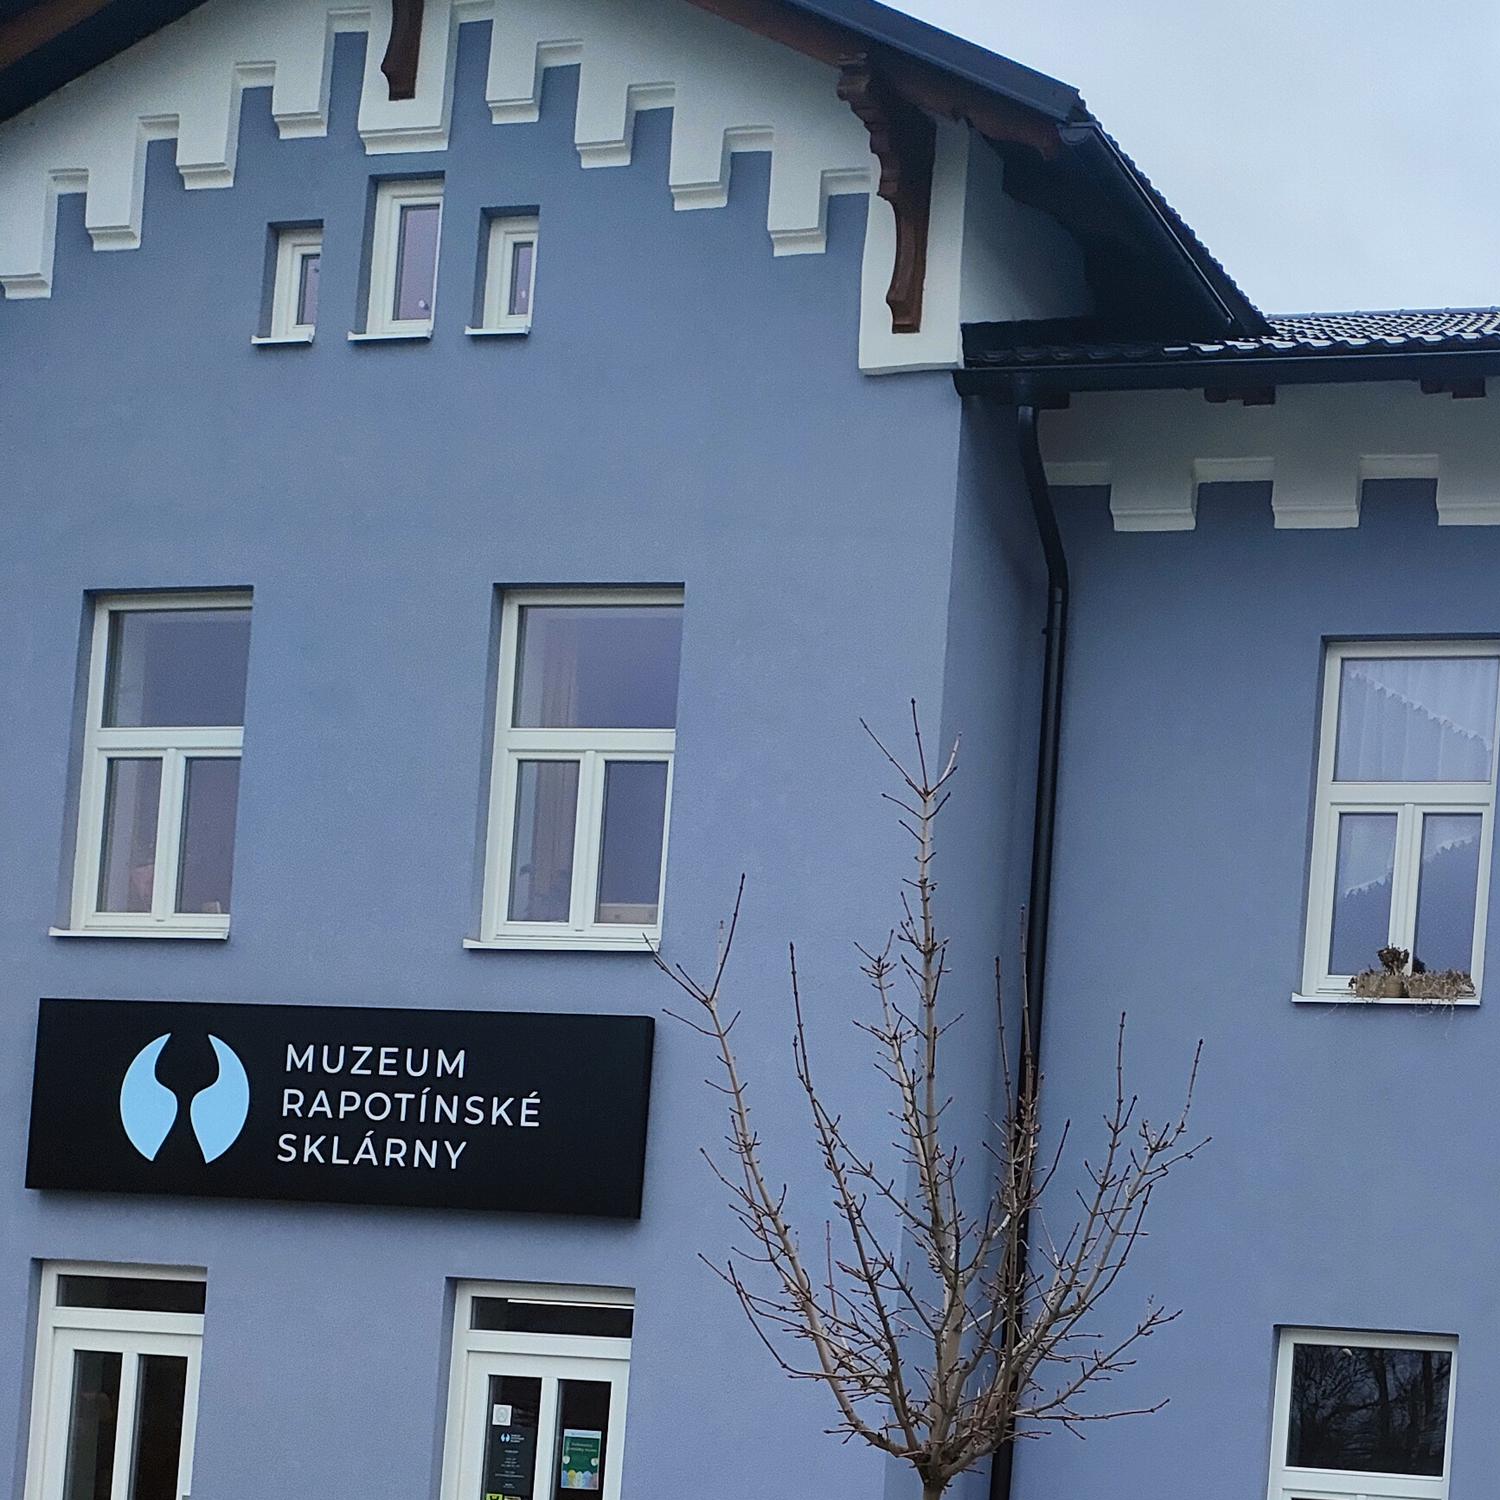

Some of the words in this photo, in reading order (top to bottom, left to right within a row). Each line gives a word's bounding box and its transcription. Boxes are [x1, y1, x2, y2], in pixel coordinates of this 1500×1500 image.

[285, 1043, 466, 1079] MUZEUM
[282, 1086, 541, 1127] RAPOTÍNSKÉ
[277, 1130, 467, 1170] SKLÁRNY
